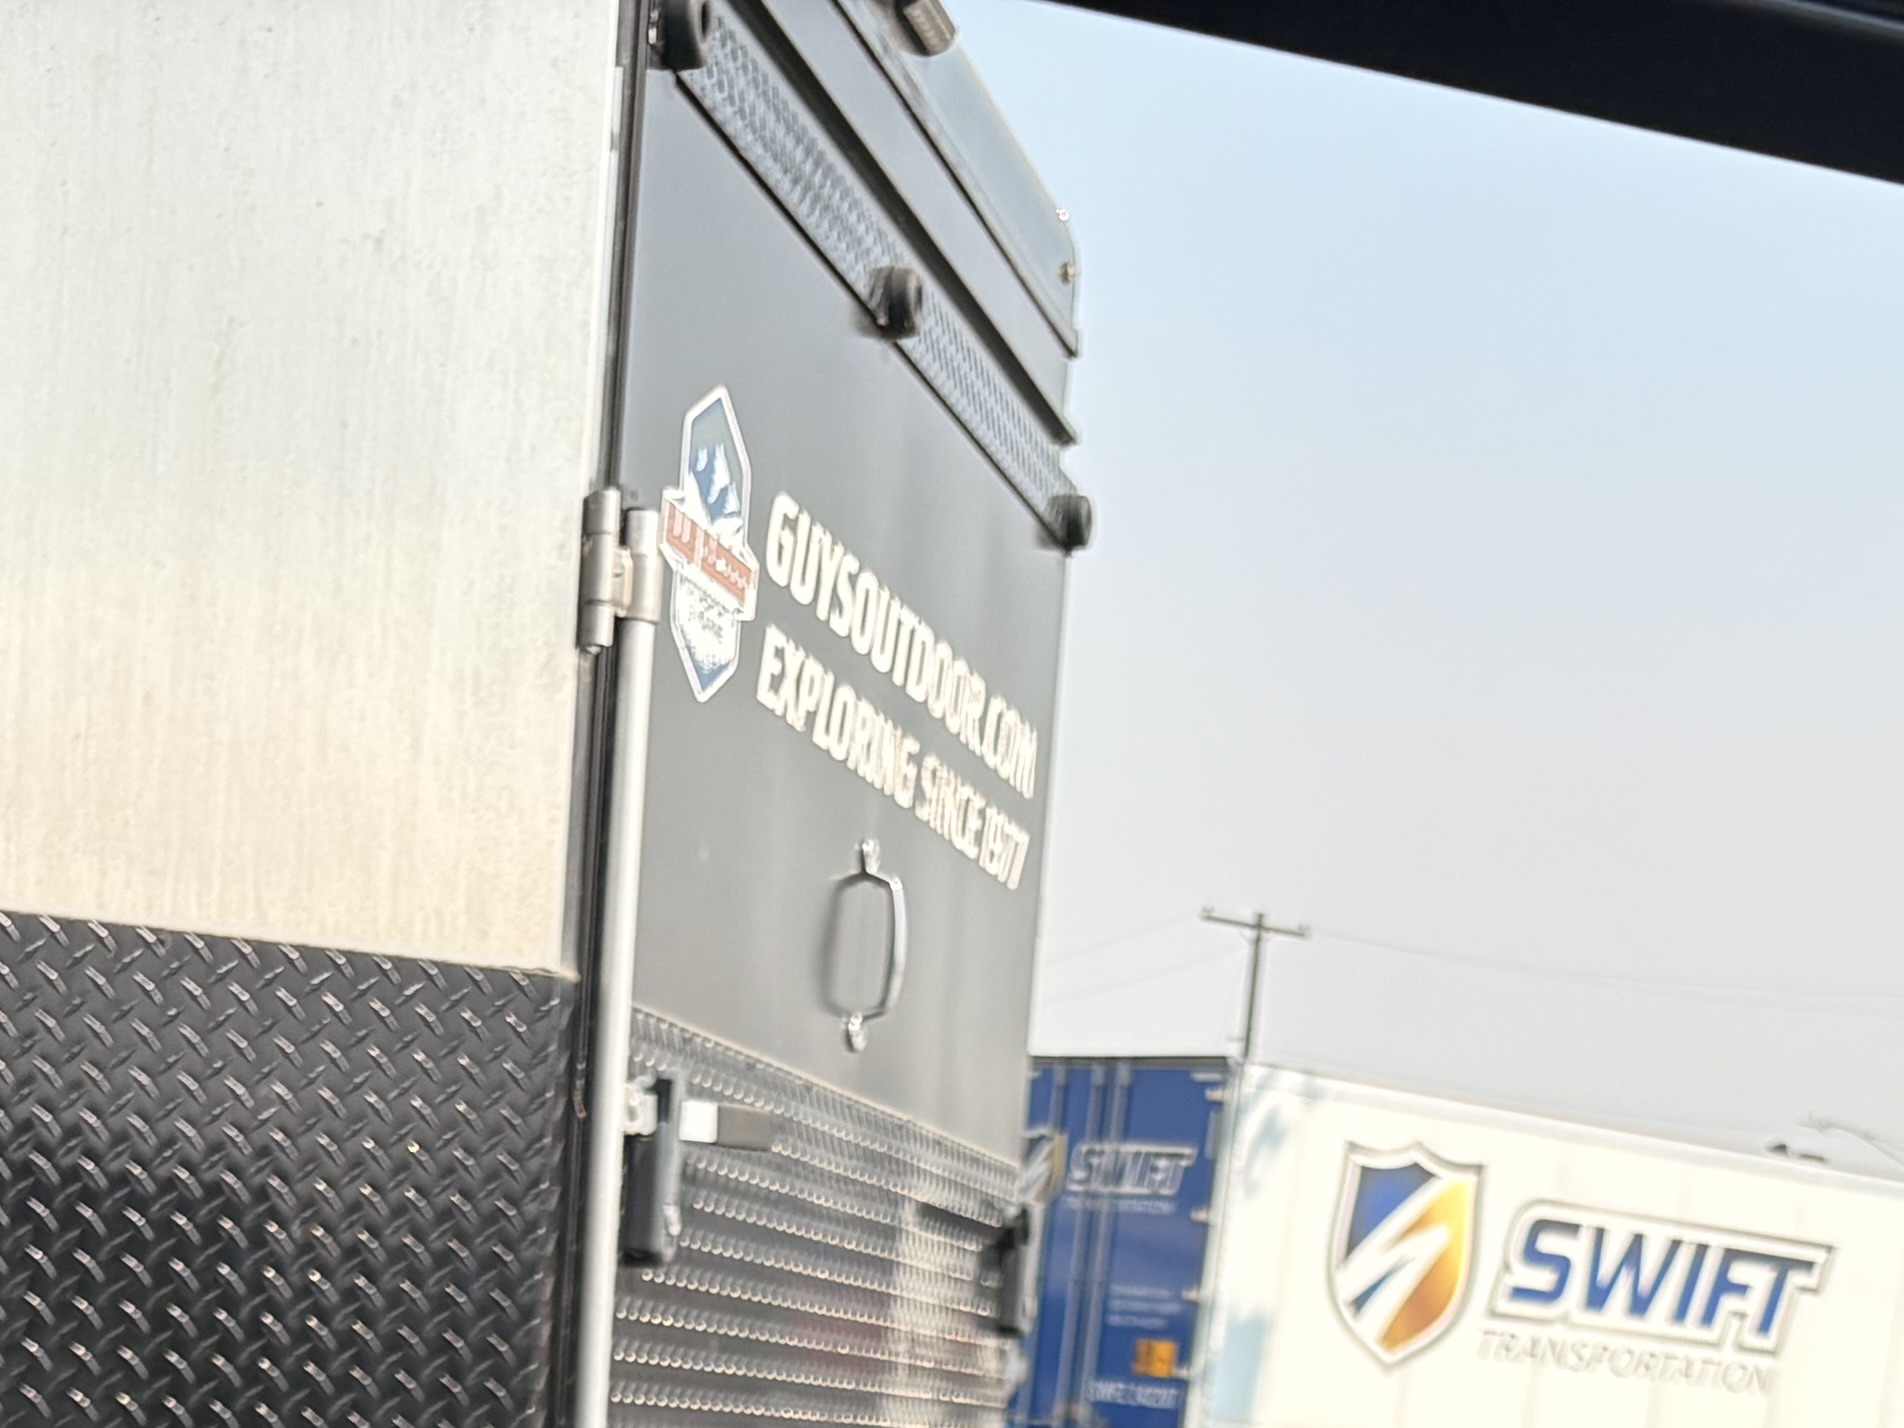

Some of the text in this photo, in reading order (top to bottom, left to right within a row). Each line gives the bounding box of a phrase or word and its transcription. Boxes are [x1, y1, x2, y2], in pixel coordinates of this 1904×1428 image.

[765, 491, 1038, 800] GUYSOUTDOOR.COM
[756, 621, 920, 809] EXPLORING
[914, 752, 986, 860] SINCE
[1477, 1330, 1774, 1397] TRANSPORTATION
[1508, 1218, 1819, 1336] SWIFT
